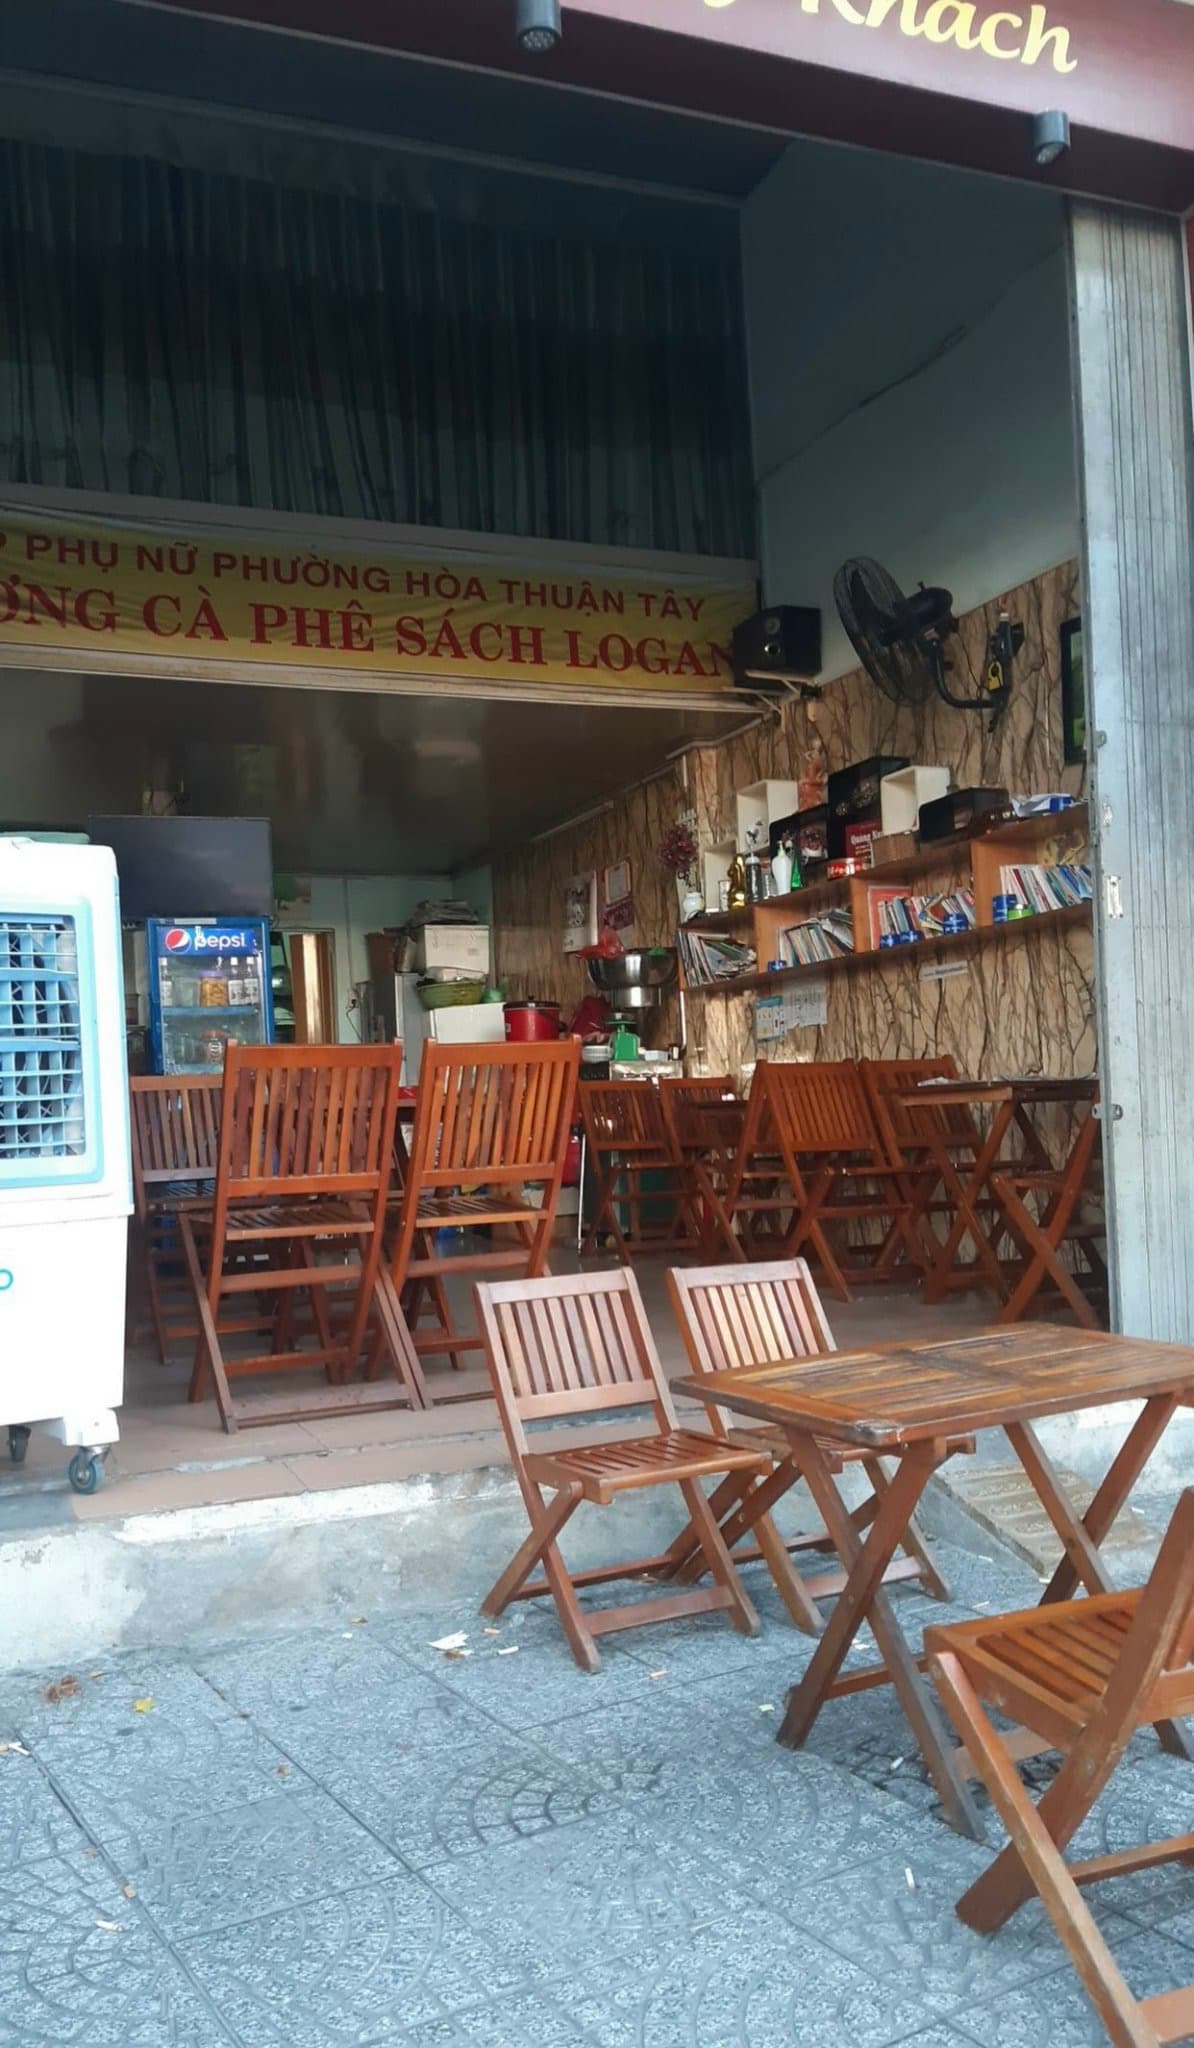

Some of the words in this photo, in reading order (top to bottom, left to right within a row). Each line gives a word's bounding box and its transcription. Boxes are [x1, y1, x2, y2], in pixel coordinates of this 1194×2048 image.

[26, 533, 118, 573] PHỤ
[137, 541, 198, 575] NỮ
[213, 552, 390, 593] PHƯỜNG
[406, 567, 487, 601] HÒA
[500, 580, 625, 616] THUẬN
[638, 589, 704, 621] TÂY
[142, 585, 228, 641] CÀ
[249, 599, 374, 652] PHÊ
[395, 608, 548, 666] SÁCH
[194, 931, 246, 951] pepsi
